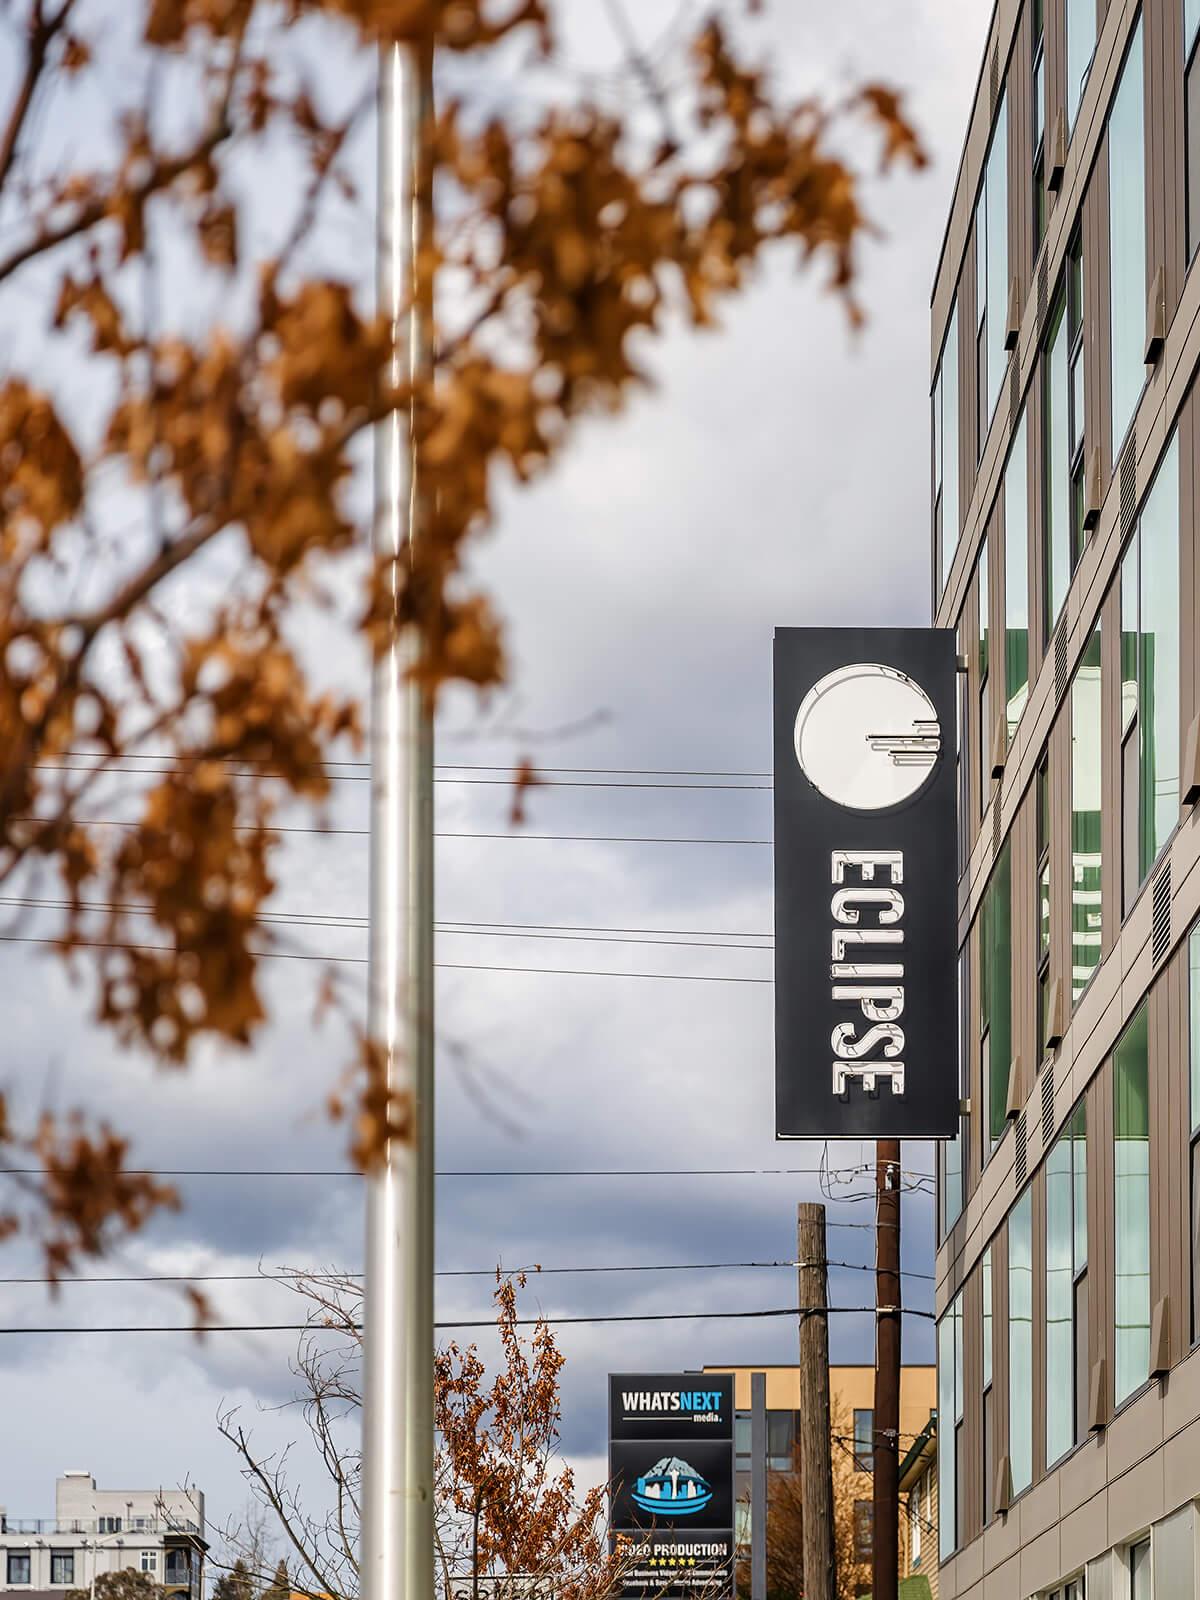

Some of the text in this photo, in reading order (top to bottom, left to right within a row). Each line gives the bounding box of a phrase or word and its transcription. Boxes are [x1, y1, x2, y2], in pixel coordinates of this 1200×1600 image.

[831, 850, 904, 1095] ECLIPSE
[622, 1391, 722, 1411] WHATSNEXT
[653, 1543, 728, 1556] PRODUCTION
